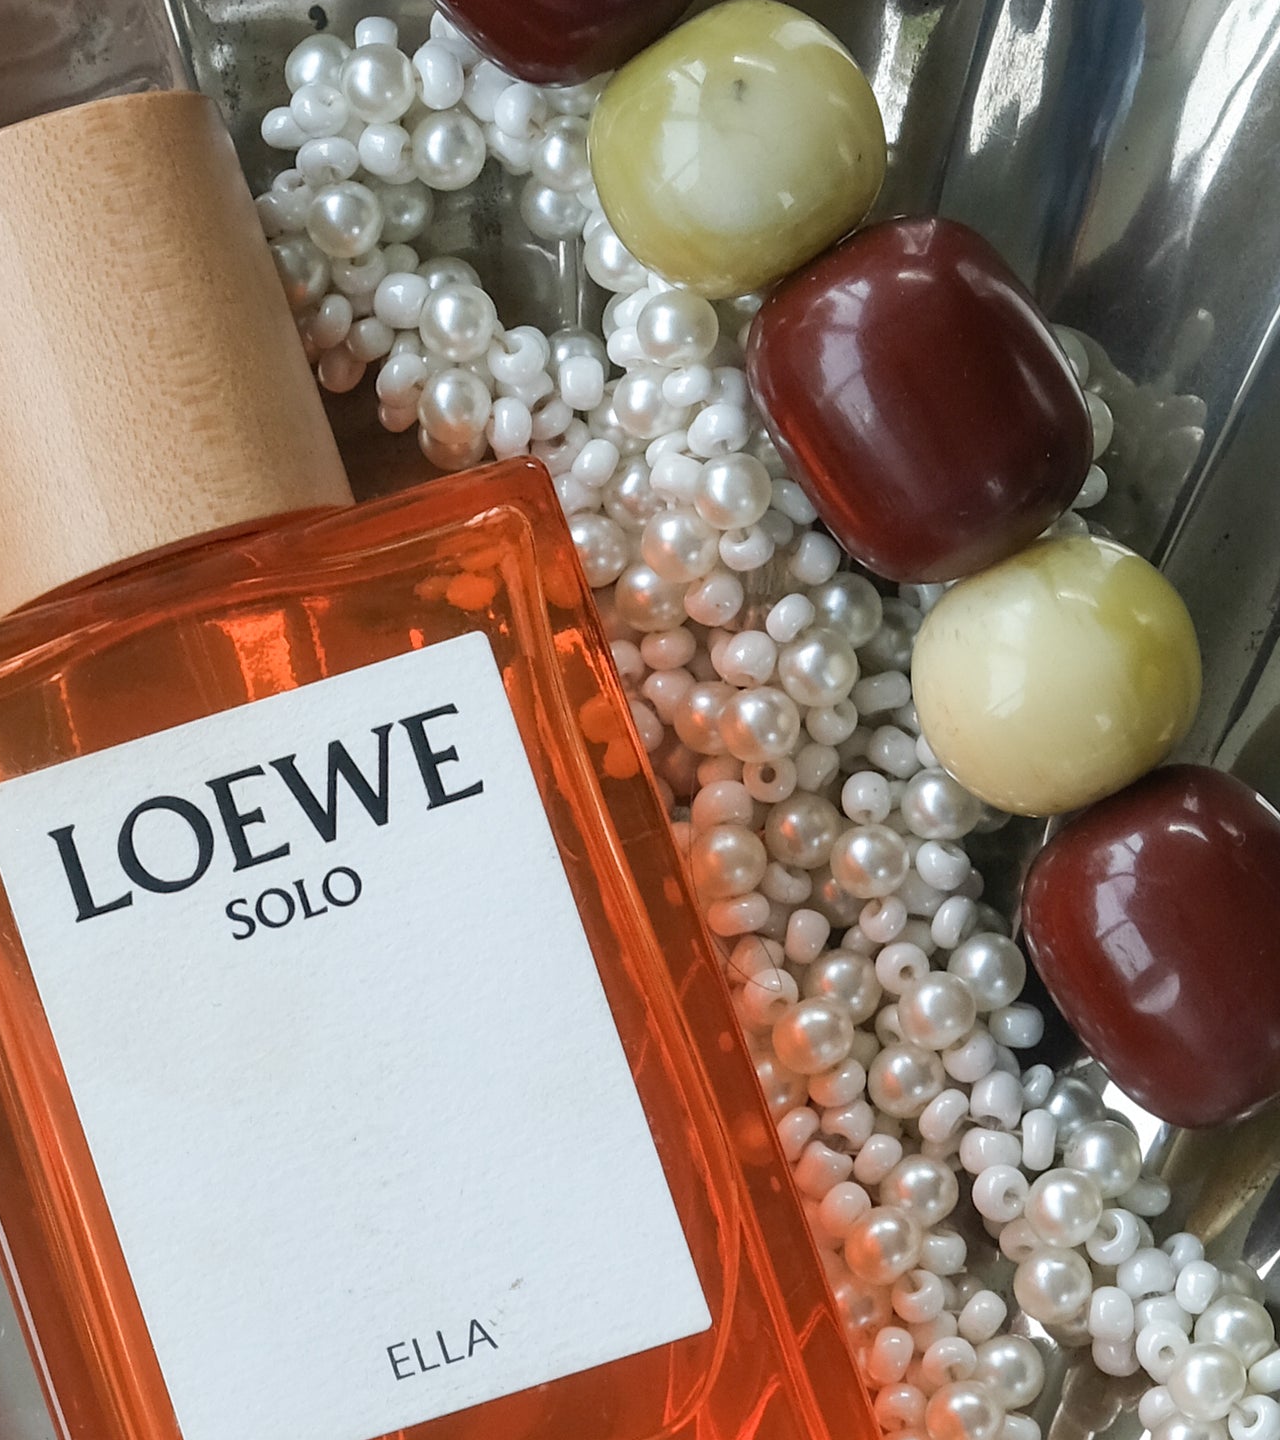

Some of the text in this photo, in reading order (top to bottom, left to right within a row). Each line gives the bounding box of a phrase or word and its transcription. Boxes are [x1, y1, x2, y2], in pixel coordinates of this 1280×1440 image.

[47, 703, 485, 923] LOEWE
[225, 866, 362, 941] SOLO
[386, 1318, 499, 1381] ELLA
